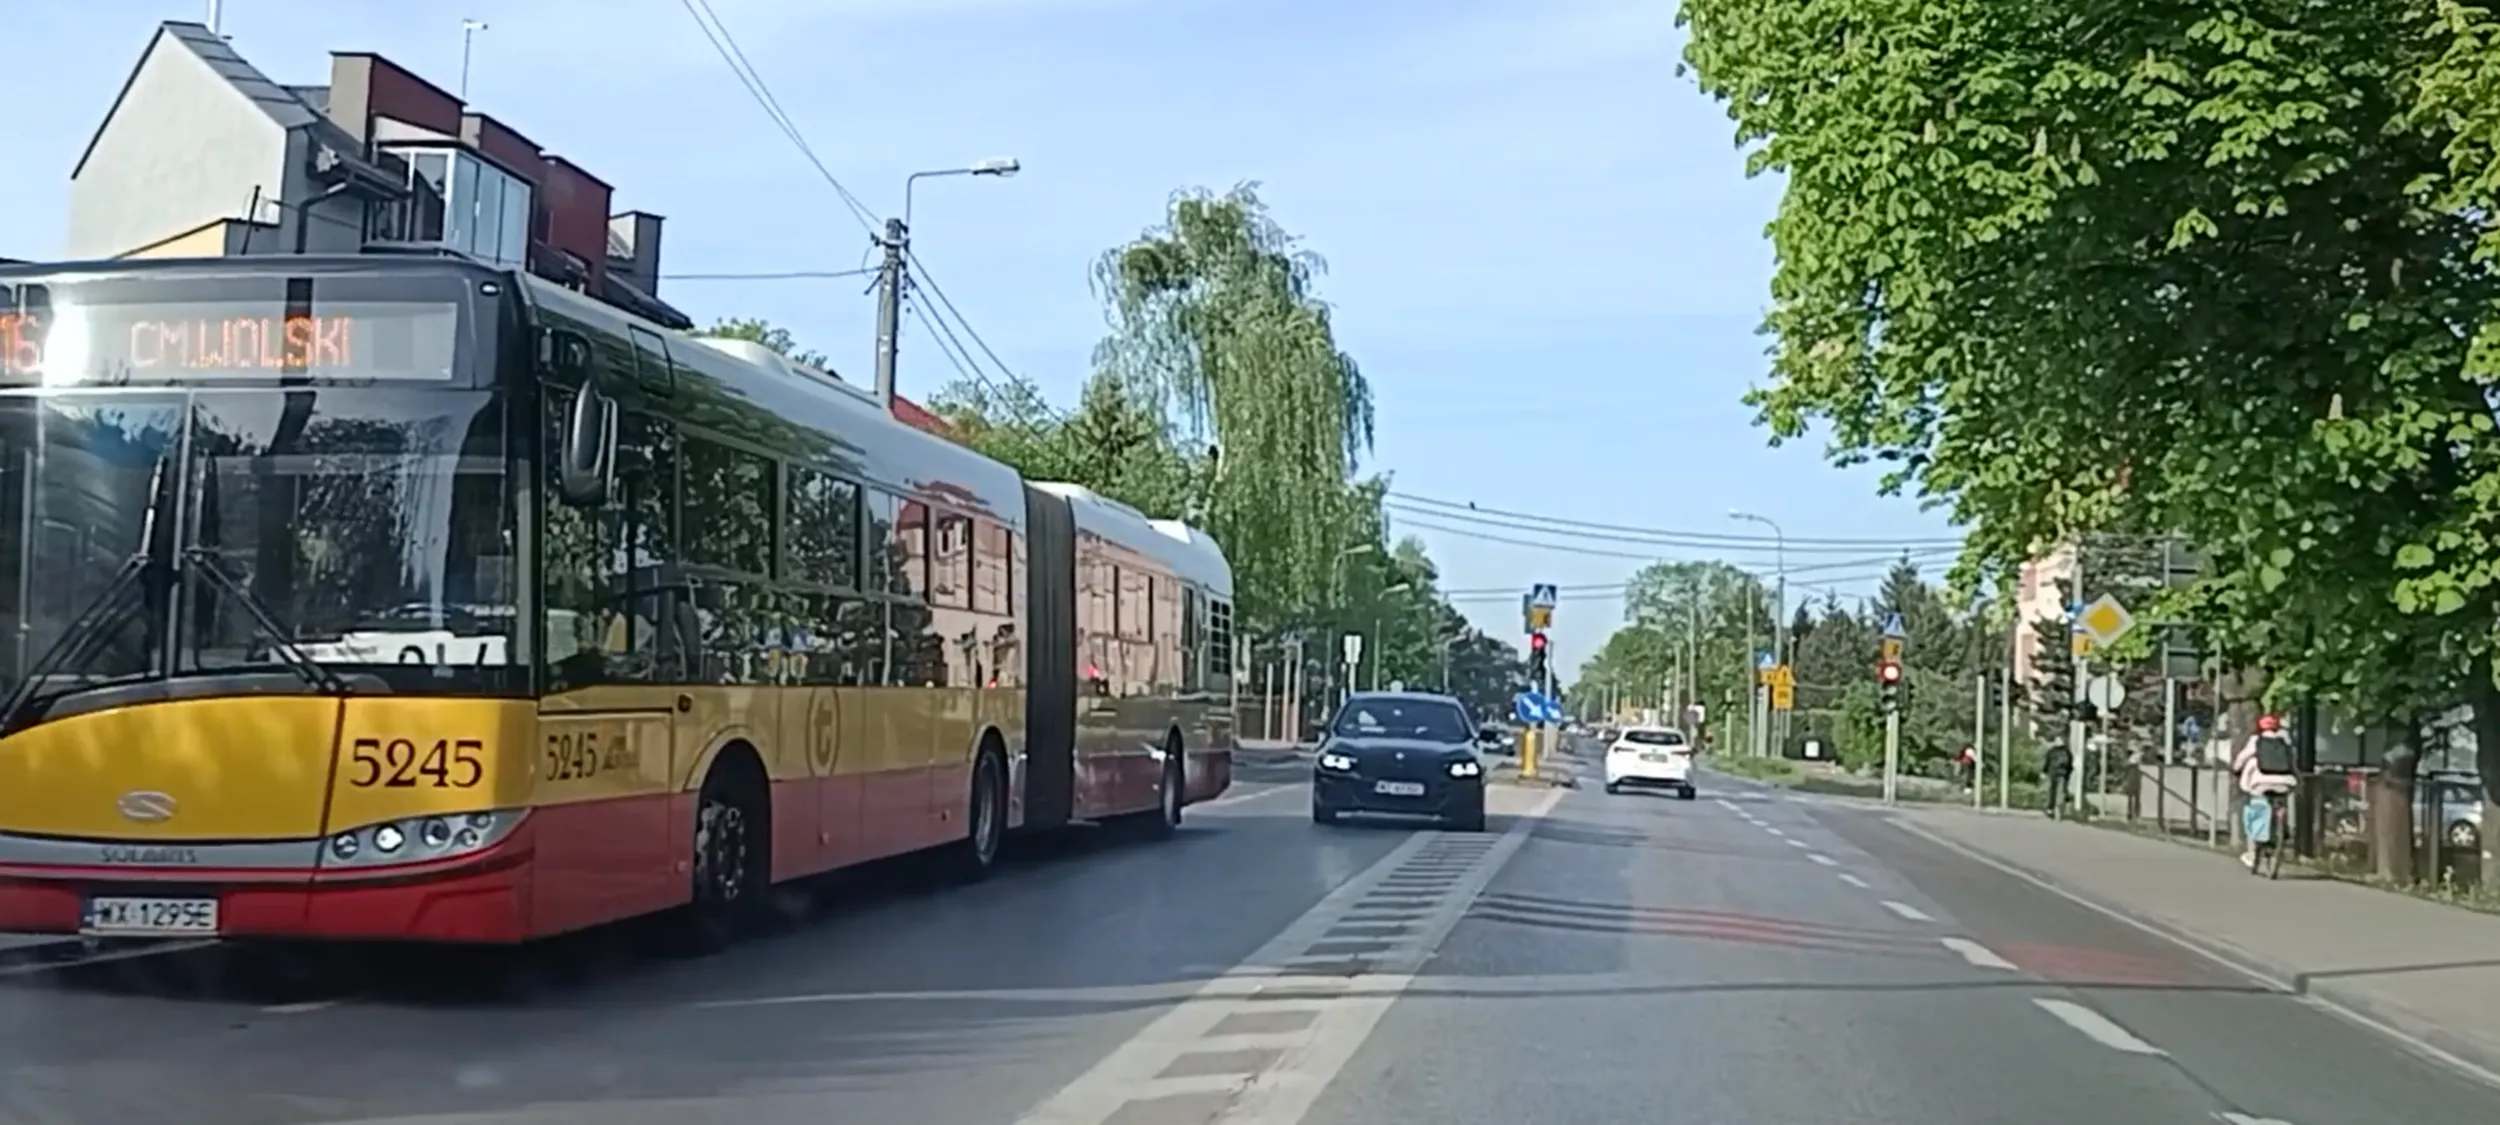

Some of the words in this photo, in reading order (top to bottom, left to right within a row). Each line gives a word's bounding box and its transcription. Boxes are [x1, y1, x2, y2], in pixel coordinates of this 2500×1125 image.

[130, 317, 354, 368] CM.WOLSKI
[350, 738, 483, 788] 5245
[545, 732, 598, 782] 5245
[99, 901, 130, 925] WX
[140, 902, 211, 927] 1295E
